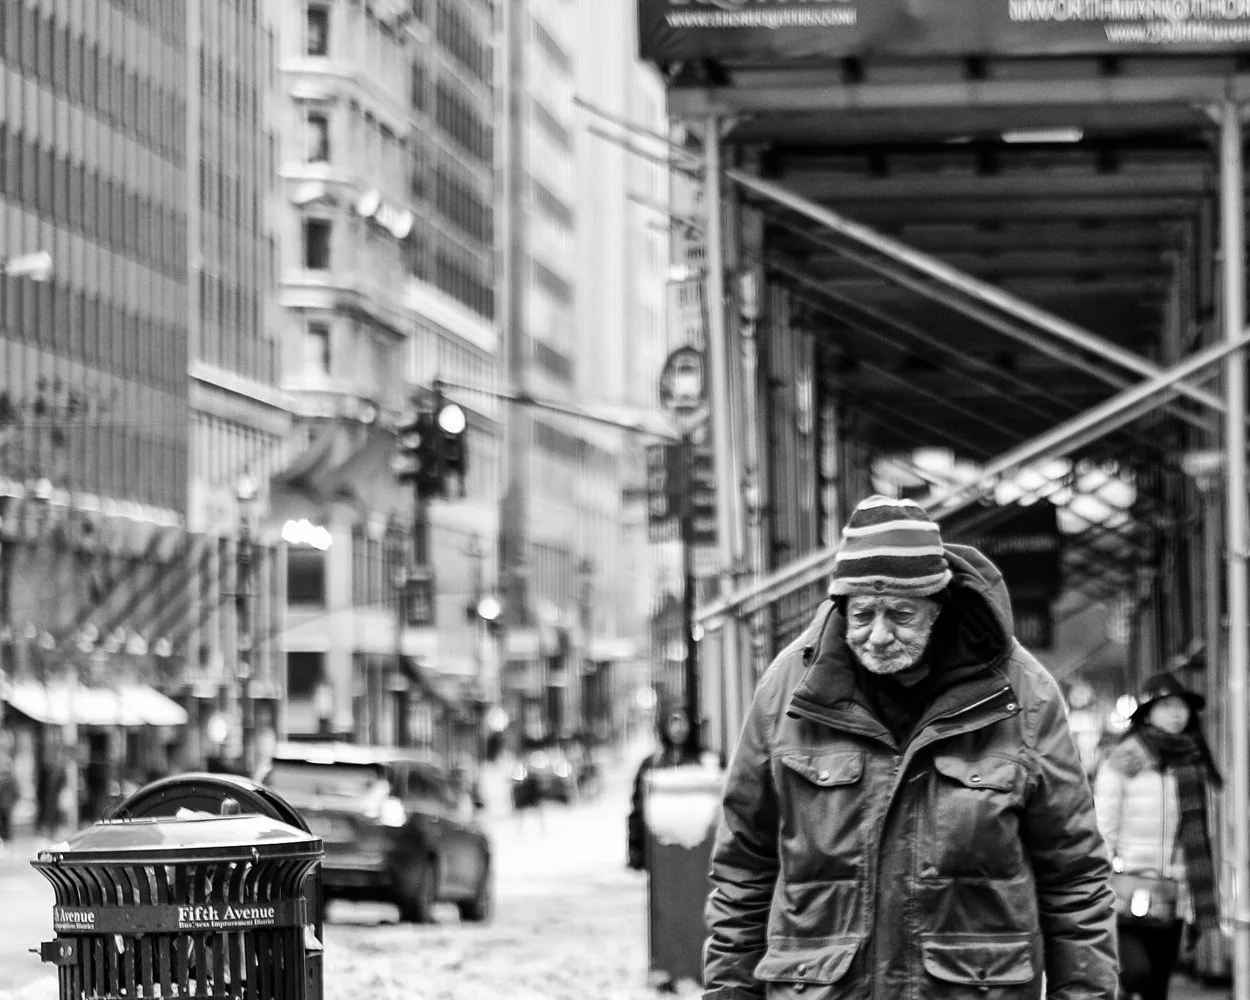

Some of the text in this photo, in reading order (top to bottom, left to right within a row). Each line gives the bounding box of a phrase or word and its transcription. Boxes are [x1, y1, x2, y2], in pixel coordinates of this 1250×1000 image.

[60, 908, 95, 923] Avenue
[178, 905, 275, 922] Fifth Avenue
